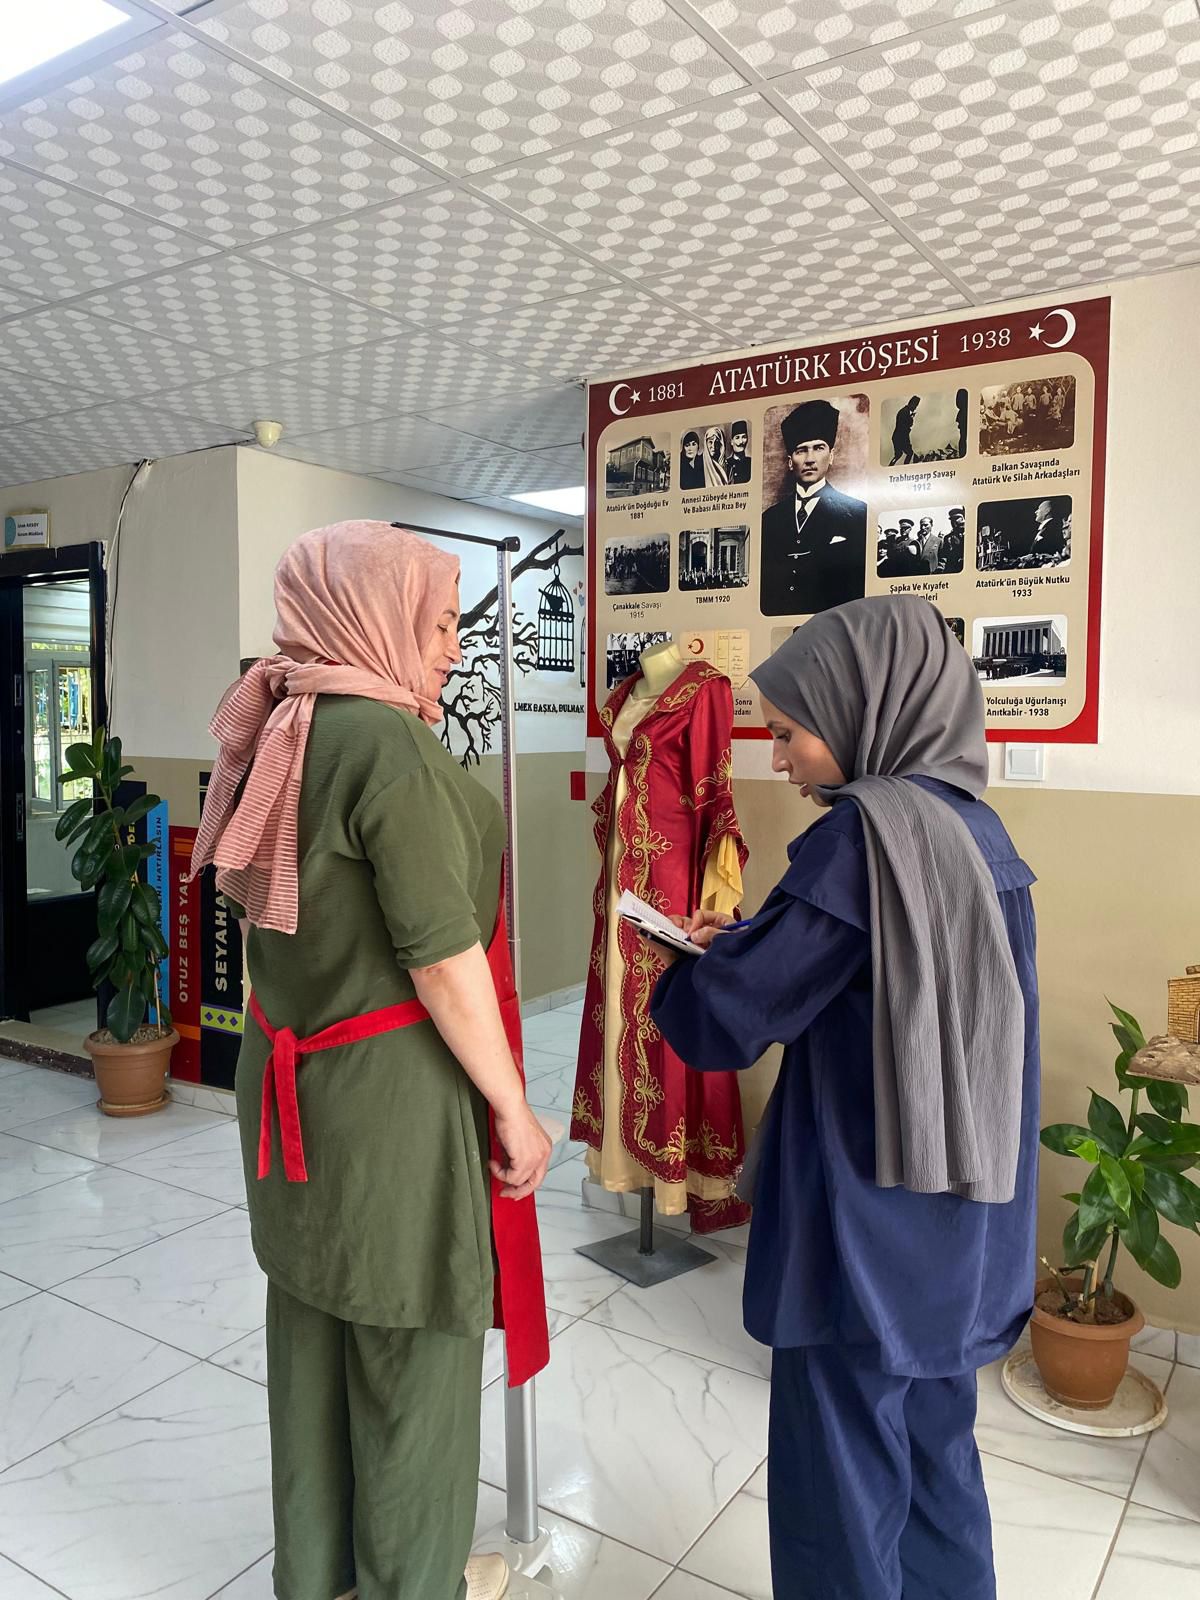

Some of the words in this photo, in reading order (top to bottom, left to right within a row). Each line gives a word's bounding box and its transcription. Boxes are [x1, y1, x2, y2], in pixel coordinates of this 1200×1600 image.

[648, 383, 685, 402] 1881
[708, 353, 831, 396] ATATÜRK
[839, 329, 940, 376] KÖŞESİ
[960, 328, 1011, 353] 1938
[992, 462, 1018, 472] Balkan
[1020, 458, 1060, 470] Savaşında
[888, 472, 932, 483] Trablusgarp
[932, 470, 956, 480] Savaşı
[972, 474, 1000, 486] Atatürk
[1002, 474, 1012, 483] Ve
[1013, 471, 1034, 482] Silah
[1034, 468, 1080, 480] Arkadaşları
[913, 483, 932, 492] 1912
[682, 496, 702, 504] Annesi
[702, 492, 728, 502] Zübeyde
[729, 490, 749, 498] Hanım
[636, 500, 661, 510] Doğduğu
[692, 505, 711, 514] Babası
[735, 502, 746, 510] Bey
[630, 512, 644, 520] 1881
[890, 584, 911, 594] Şapka
[923, 581, 949, 592] Kıyafet
[976, 577, 1017, 588] Atatürk'ün
[1018, 576, 1044, 588] Büyük
[1045, 576, 1070, 585] Nutku
[1012, 589, 1032, 598] 1933
[612, 602, 640, 612] Çanakkale
[641, 601, 662, 610] Savaşı
[514, 702, 532, 711] LMEK
[986, 696, 1024, 707] Yolculuğa
[1025, 696, 1067, 707] Uğurlanışı
[986, 708, 1023, 717] Anıtkabir
[1029, 708, 1049, 717] 1938
[179, 914, 190, 949] BEŞ
[215, 888, 228, 992] SEYAHA
[179, 956, 188, 1003] OTUZ
